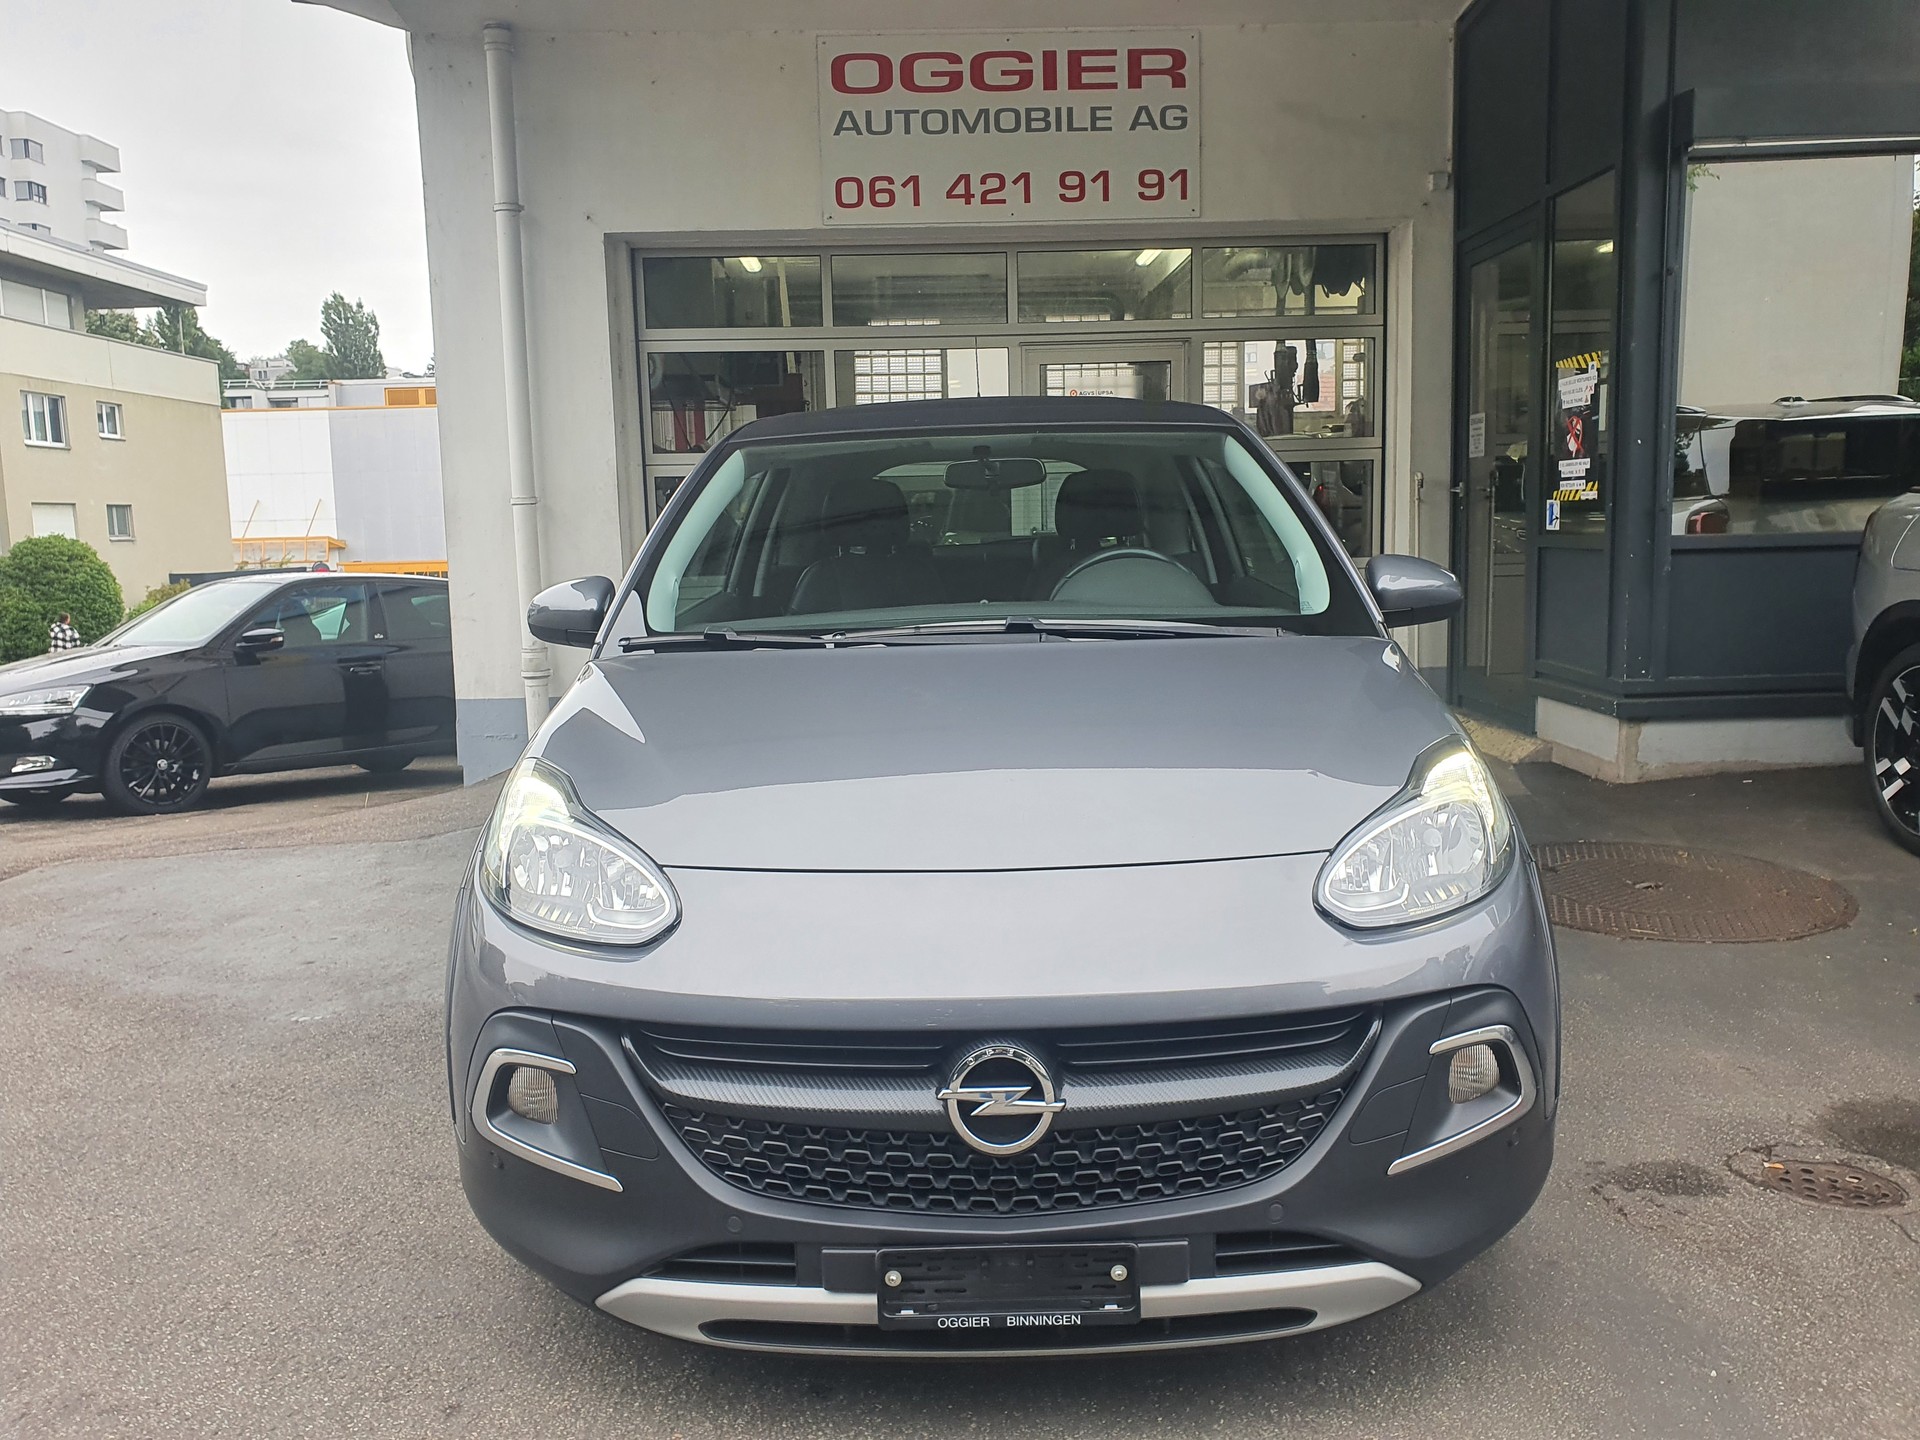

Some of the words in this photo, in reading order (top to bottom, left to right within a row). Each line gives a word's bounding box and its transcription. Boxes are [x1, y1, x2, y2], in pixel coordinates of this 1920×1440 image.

[831, 48, 1187, 94] OGGIER
[833, 106, 1113, 136] AUTOMOBILE
[1129, 105, 1188, 132] AG
[835, 175, 921, 209] 061
[946, 172, 1031, 205] 421
[1059, 170, 1109, 202] 91
[1138, 169, 1188, 201] 91
[937, 1317, 990, 1328] OGGIER
[1006, 1314, 1081, 1327] BINNINGEN
